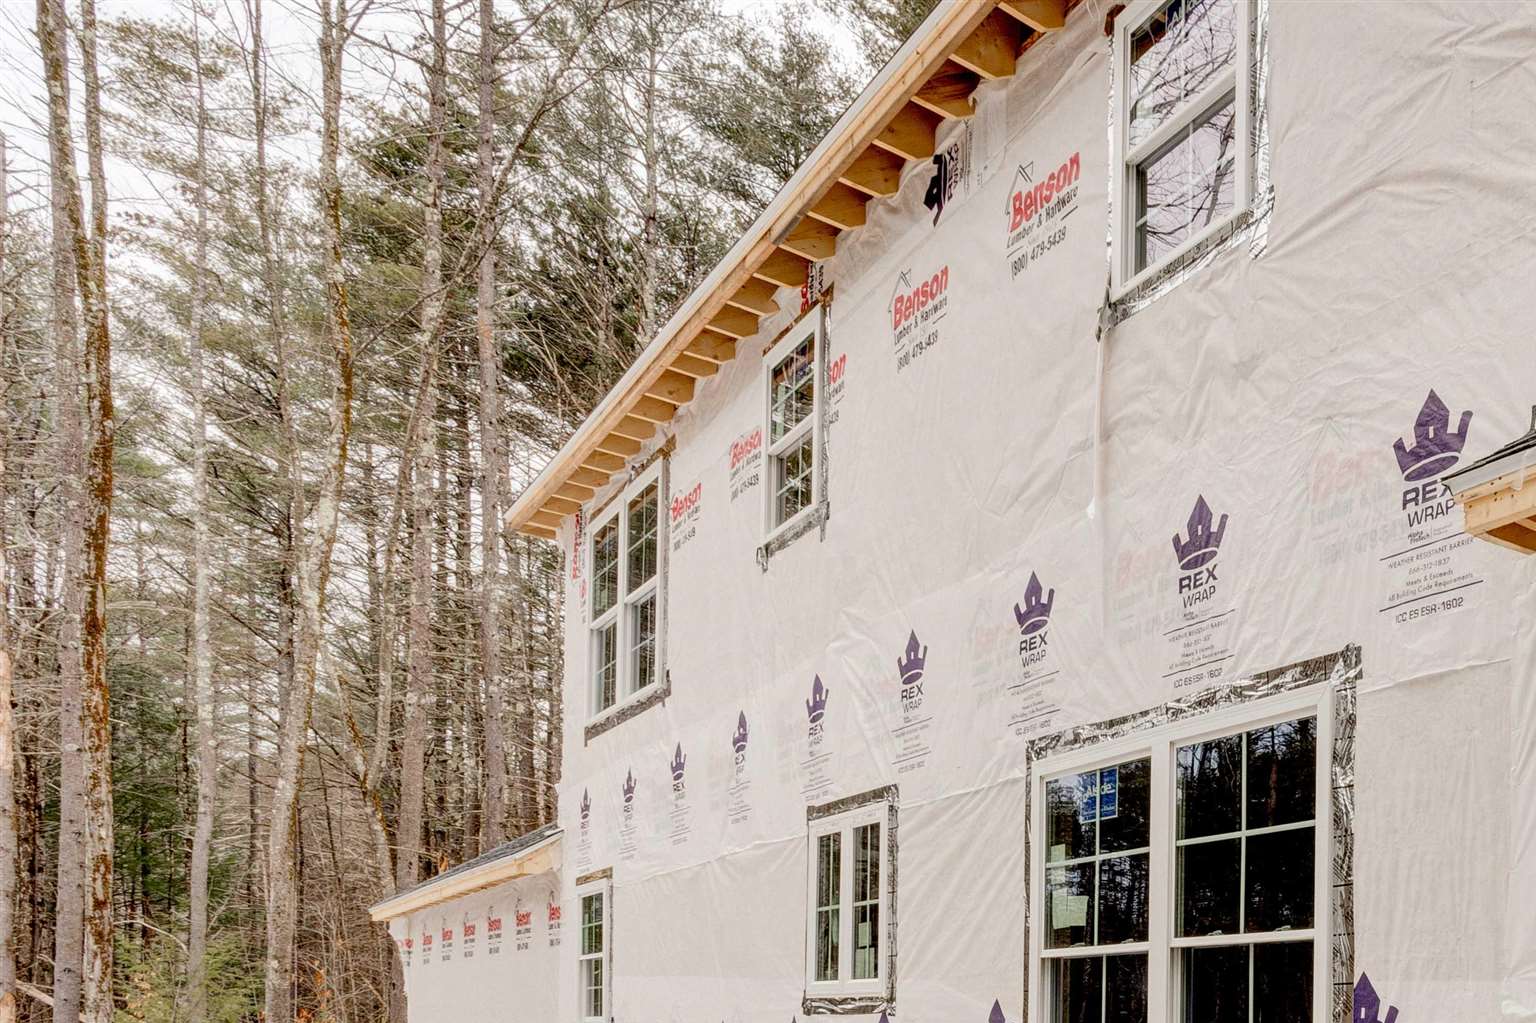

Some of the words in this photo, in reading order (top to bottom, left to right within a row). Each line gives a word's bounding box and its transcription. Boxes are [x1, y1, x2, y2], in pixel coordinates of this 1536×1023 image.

[1009, 152, 1081, 233] Benson
[1030, 225, 1067, 261] 479-5439
[893, 265, 949, 331] Benson
[1408, 498, 1455, 527] WRAP
[1389, 557, 1414, 569] WEATHER
[1416, 546, 1447, 561] RESISTANT
[1449, 538, 1474, 552] BARRIER
[1178, 563, 1218, 594] REX
[1417, 583, 1433, 592] Code
[1434, 572, 1474, 588] Requirements
[1183, 585, 1216, 608] WRAP
[1395, 613, 1407, 624] ICC
[1409, 609, 1420, 620] ES
[1019, 631, 1048, 655] REX
[1021, 649, 1047, 668] WRAP
[901, 683, 924, 702] REX
